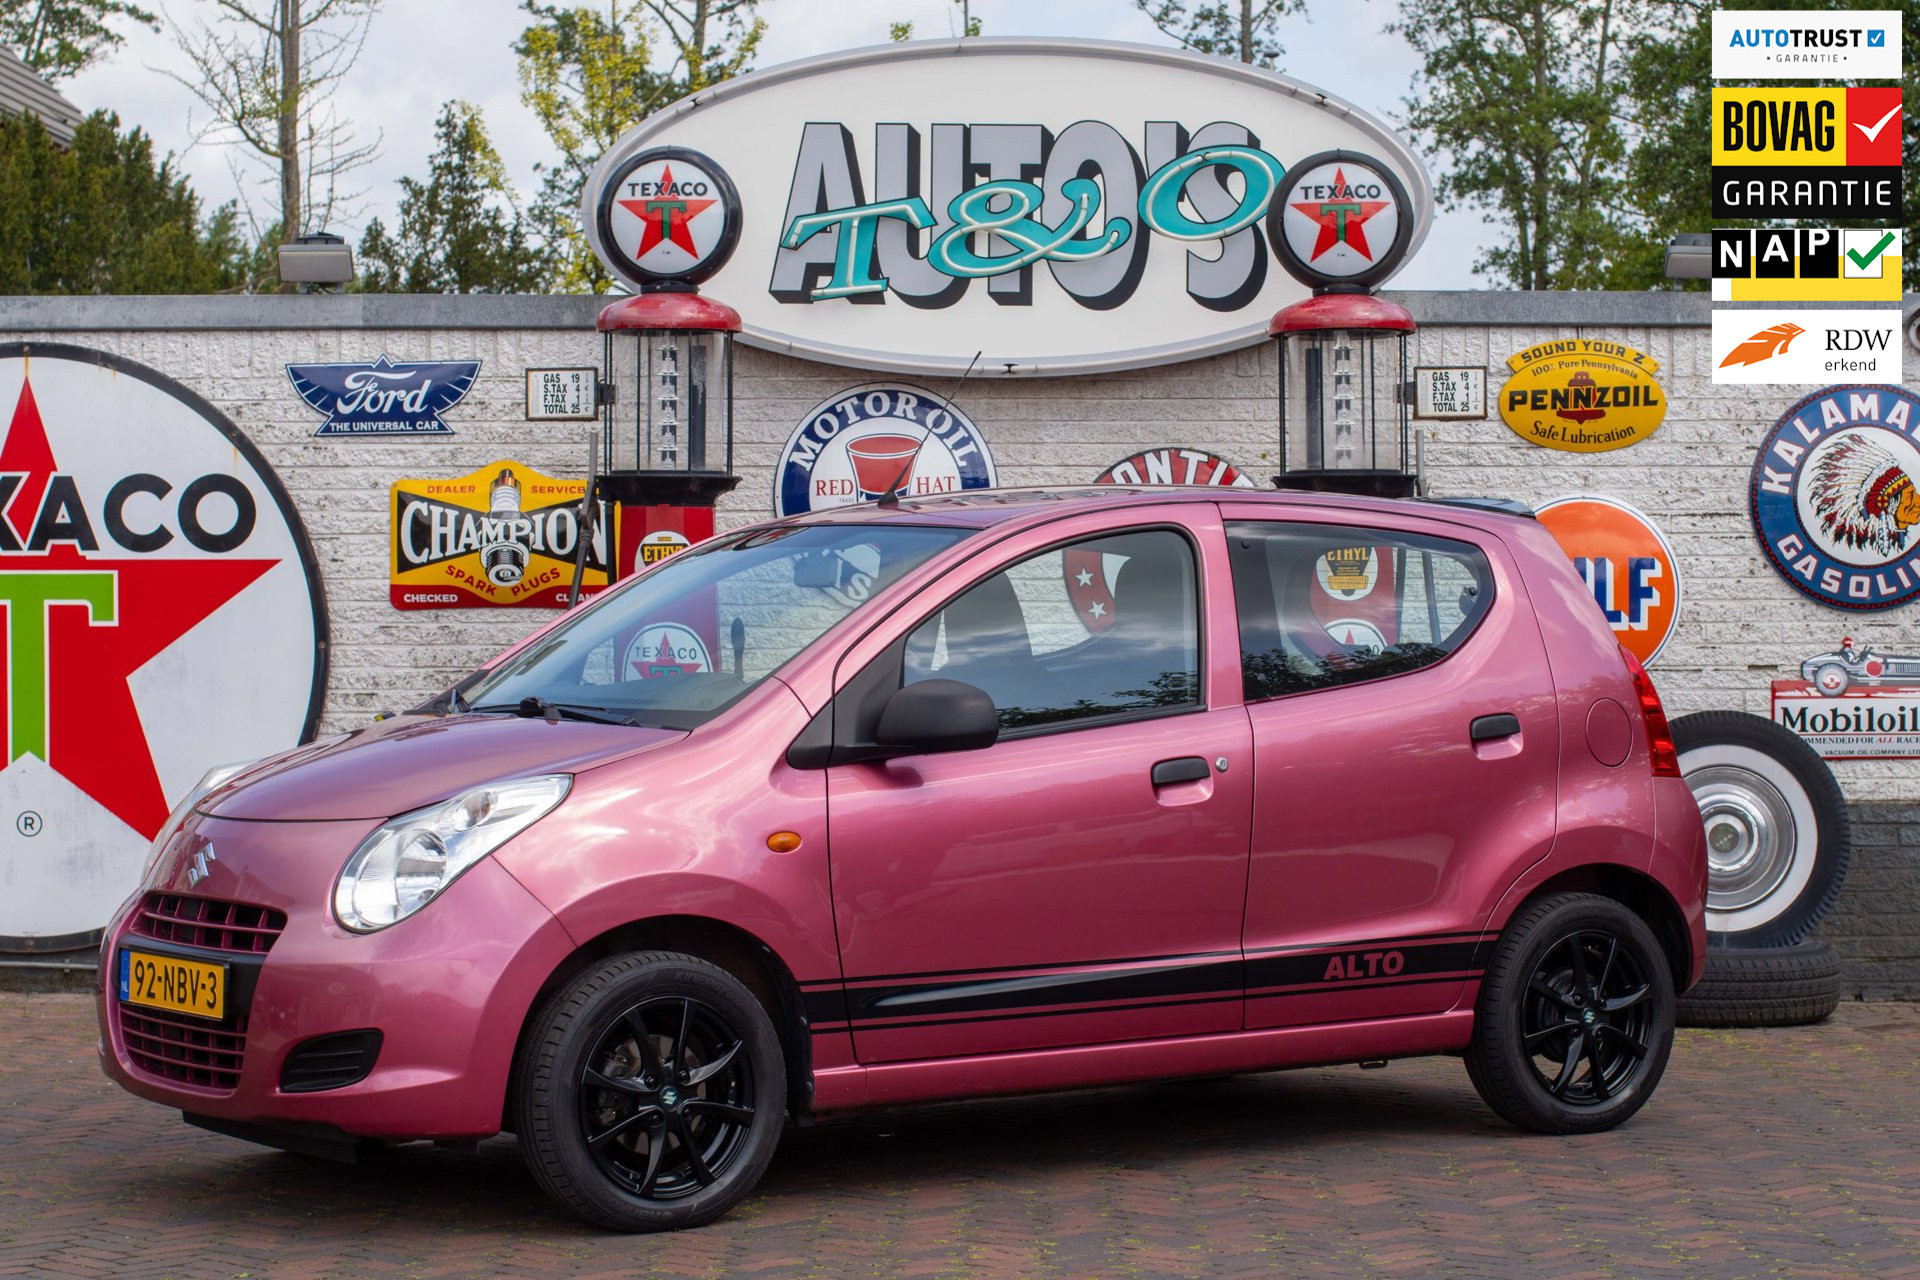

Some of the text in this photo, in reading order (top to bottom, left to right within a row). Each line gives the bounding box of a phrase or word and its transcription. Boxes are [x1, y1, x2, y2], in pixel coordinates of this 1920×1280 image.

[628, 182, 708, 197] TEXACO
[1300, 184, 1381, 200] TEXACO
[1521, 341, 1647, 365] SOUND YOUR Z
[1432, 371, 1450, 381] GAS
[1460, 371, 1469, 381] 19
[1558, 360, 1579, 369] Pure
[1581, 359, 1638, 380] Pennsylvania
[543, 373, 561, 383] GAS
[571, 373, 580, 383] 19
[337, 370, 432, 415] Ford
[543, 383, 568, 393] S.TAX
[575, 384, 580, 393] 4
[1432, 382, 1457, 391] S.TAX
[1464, 382, 1470, 391] 4
[543, 394, 566, 403] F.TAX
[576, 394, 580, 403] 1
[1432, 392, 1456, 402] F.TAX
[1465, 392, 1470, 402] 1
[1508, 385, 1660, 412] PENNZOIL
[543, 404, 568, 414] TOTAL
[571, 404, 581, 414] 25
[1433, 402, 1458, 412] TOTAL
[1460, 402, 1470, 412] 25
[329, 420, 439, 432] THE UNIVERSAL CAR
[789, 391, 978, 472] MOTOR OIL
[1530, 420, 1636, 445] Safe Lubrication
[427, 485, 476, 494] DEALER
[815, 475, 956, 496] RED HAT
[643, 545, 684, 562] ETHY
[445, 564, 561, 597] SPARK PLUGS
[403, 593, 458, 603] CHECKED
[635, 645, 697, 660] TEXACO
[1781, 705, 1920, 733] Mobiloil
[1856, 736, 1874, 744] FOR
[1877, 736, 1893, 744] ALL
[1323, 951, 1405, 980] ALTO
[134, 959, 218, 1009] 92-NBV-3
